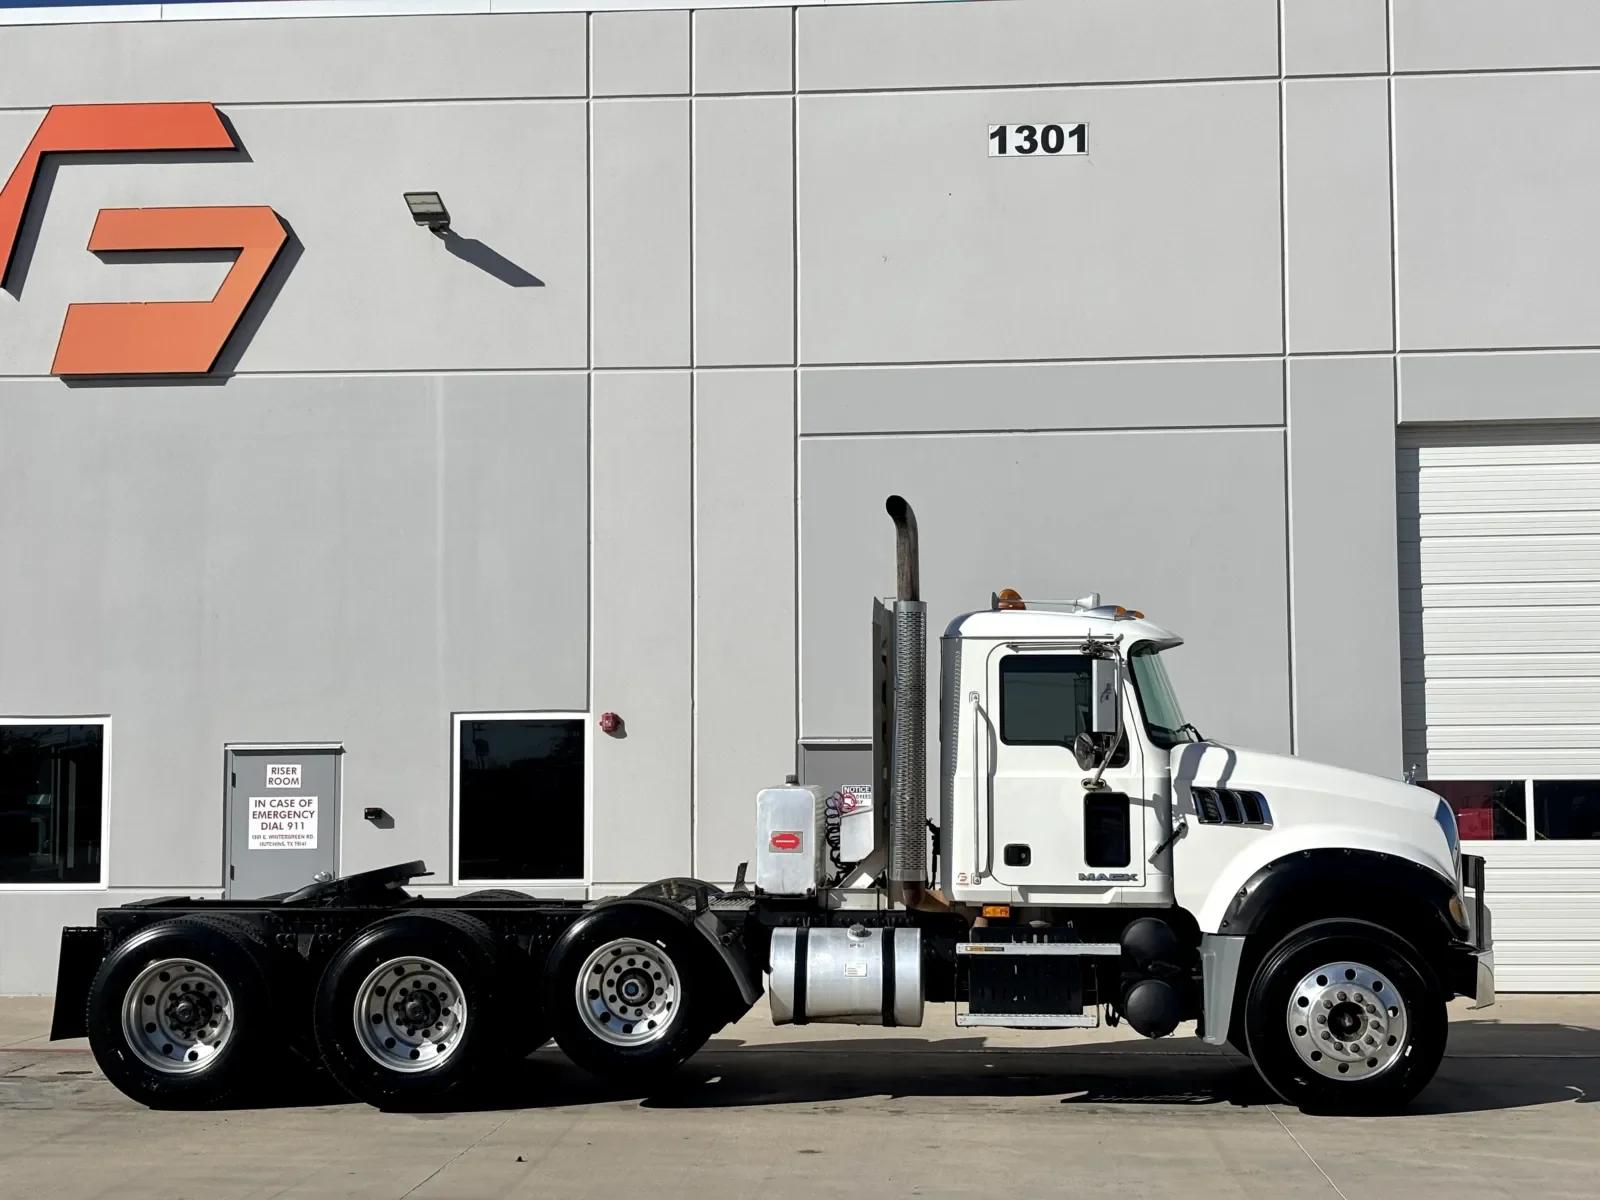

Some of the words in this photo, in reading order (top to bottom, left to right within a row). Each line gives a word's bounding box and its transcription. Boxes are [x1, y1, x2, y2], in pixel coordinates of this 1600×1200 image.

[990, 124, 1085, 154] 1301
[271, 767, 297, 775] RISER
[268, 777, 300, 786] ROOM
[254, 800, 266, 808] IN
[269, 799, 295, 808] CASE
[298, 799, 313, 807] OF
[252, 810, 315, 820] EMERGENCY
[260, 822, 284, 831] DIAL
[287, 821, 305, 831] 911
[1078, 872, 1139, 882] MACK
